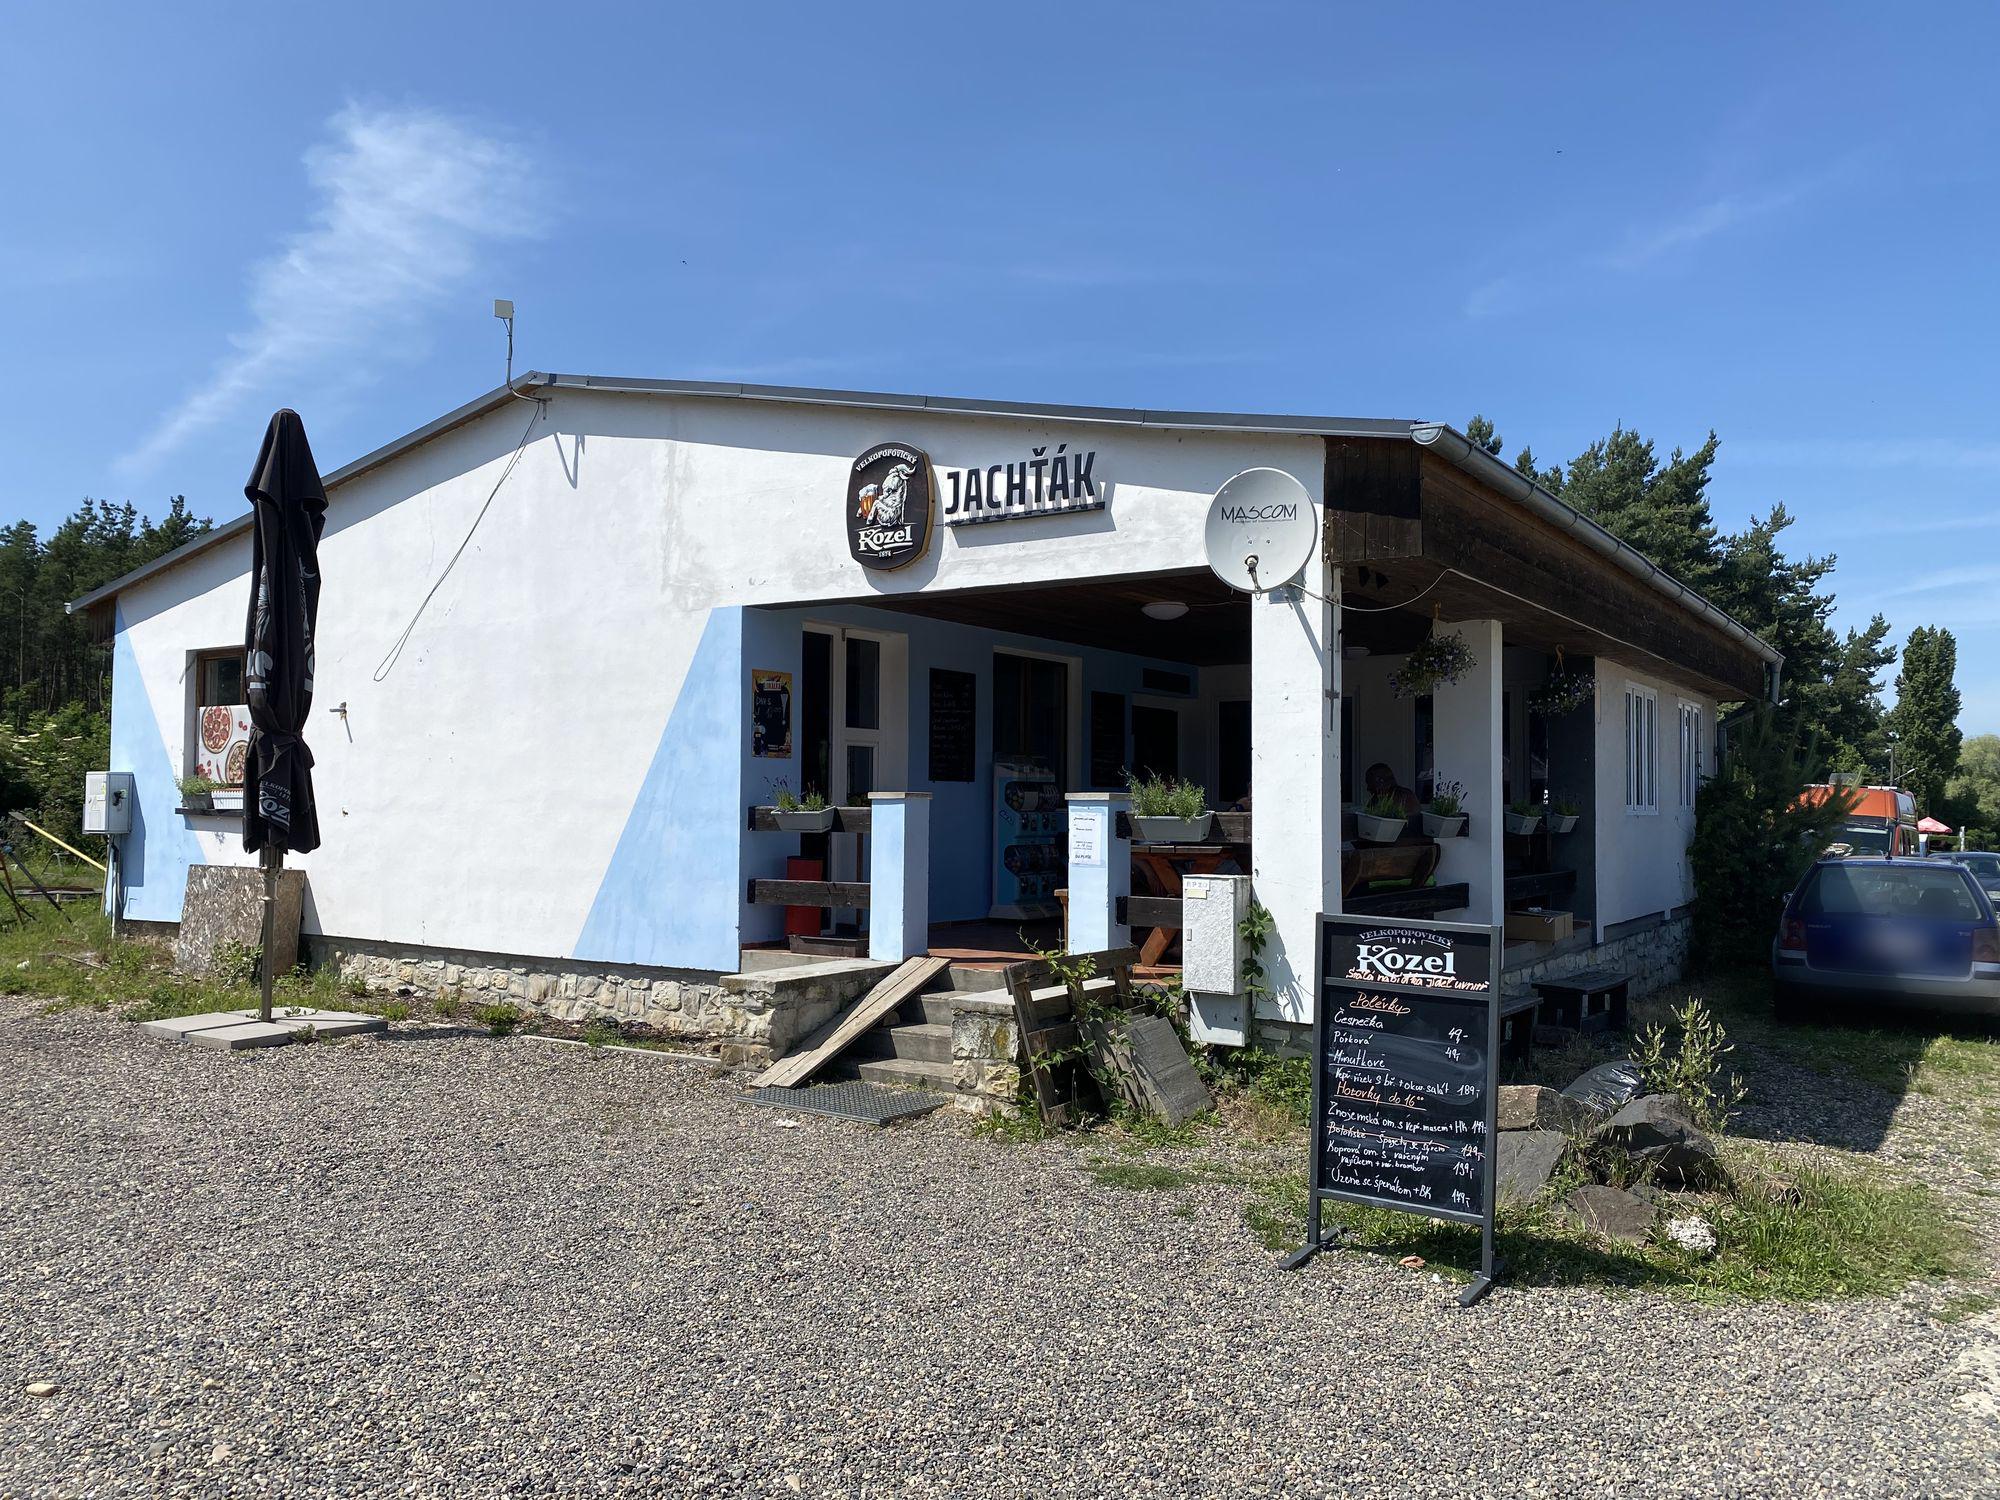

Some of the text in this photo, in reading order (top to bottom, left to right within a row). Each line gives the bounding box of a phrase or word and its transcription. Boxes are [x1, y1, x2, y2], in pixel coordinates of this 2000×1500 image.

[945, 444, 1095, 514] JACHŤÁK
[1222, 504, 1296, 523] MASCOM
[858, 525, 913, 551] Kozel
[1357, 944, 1457, 977] Kozel
[1352, 991, 1408, 1016] Polévky
[1334, 1007, 1384, 1029] Česnečka
[1334, 1031, 1373, 1045] Pórková
[1336, 1080, 1381, 1105] Hotovky
[1388, 1091, 1401, 1104] do
[1328, 1101, 1380, 1125] Znojemská
[1327, 1139, 1361, 1157] Koprová
